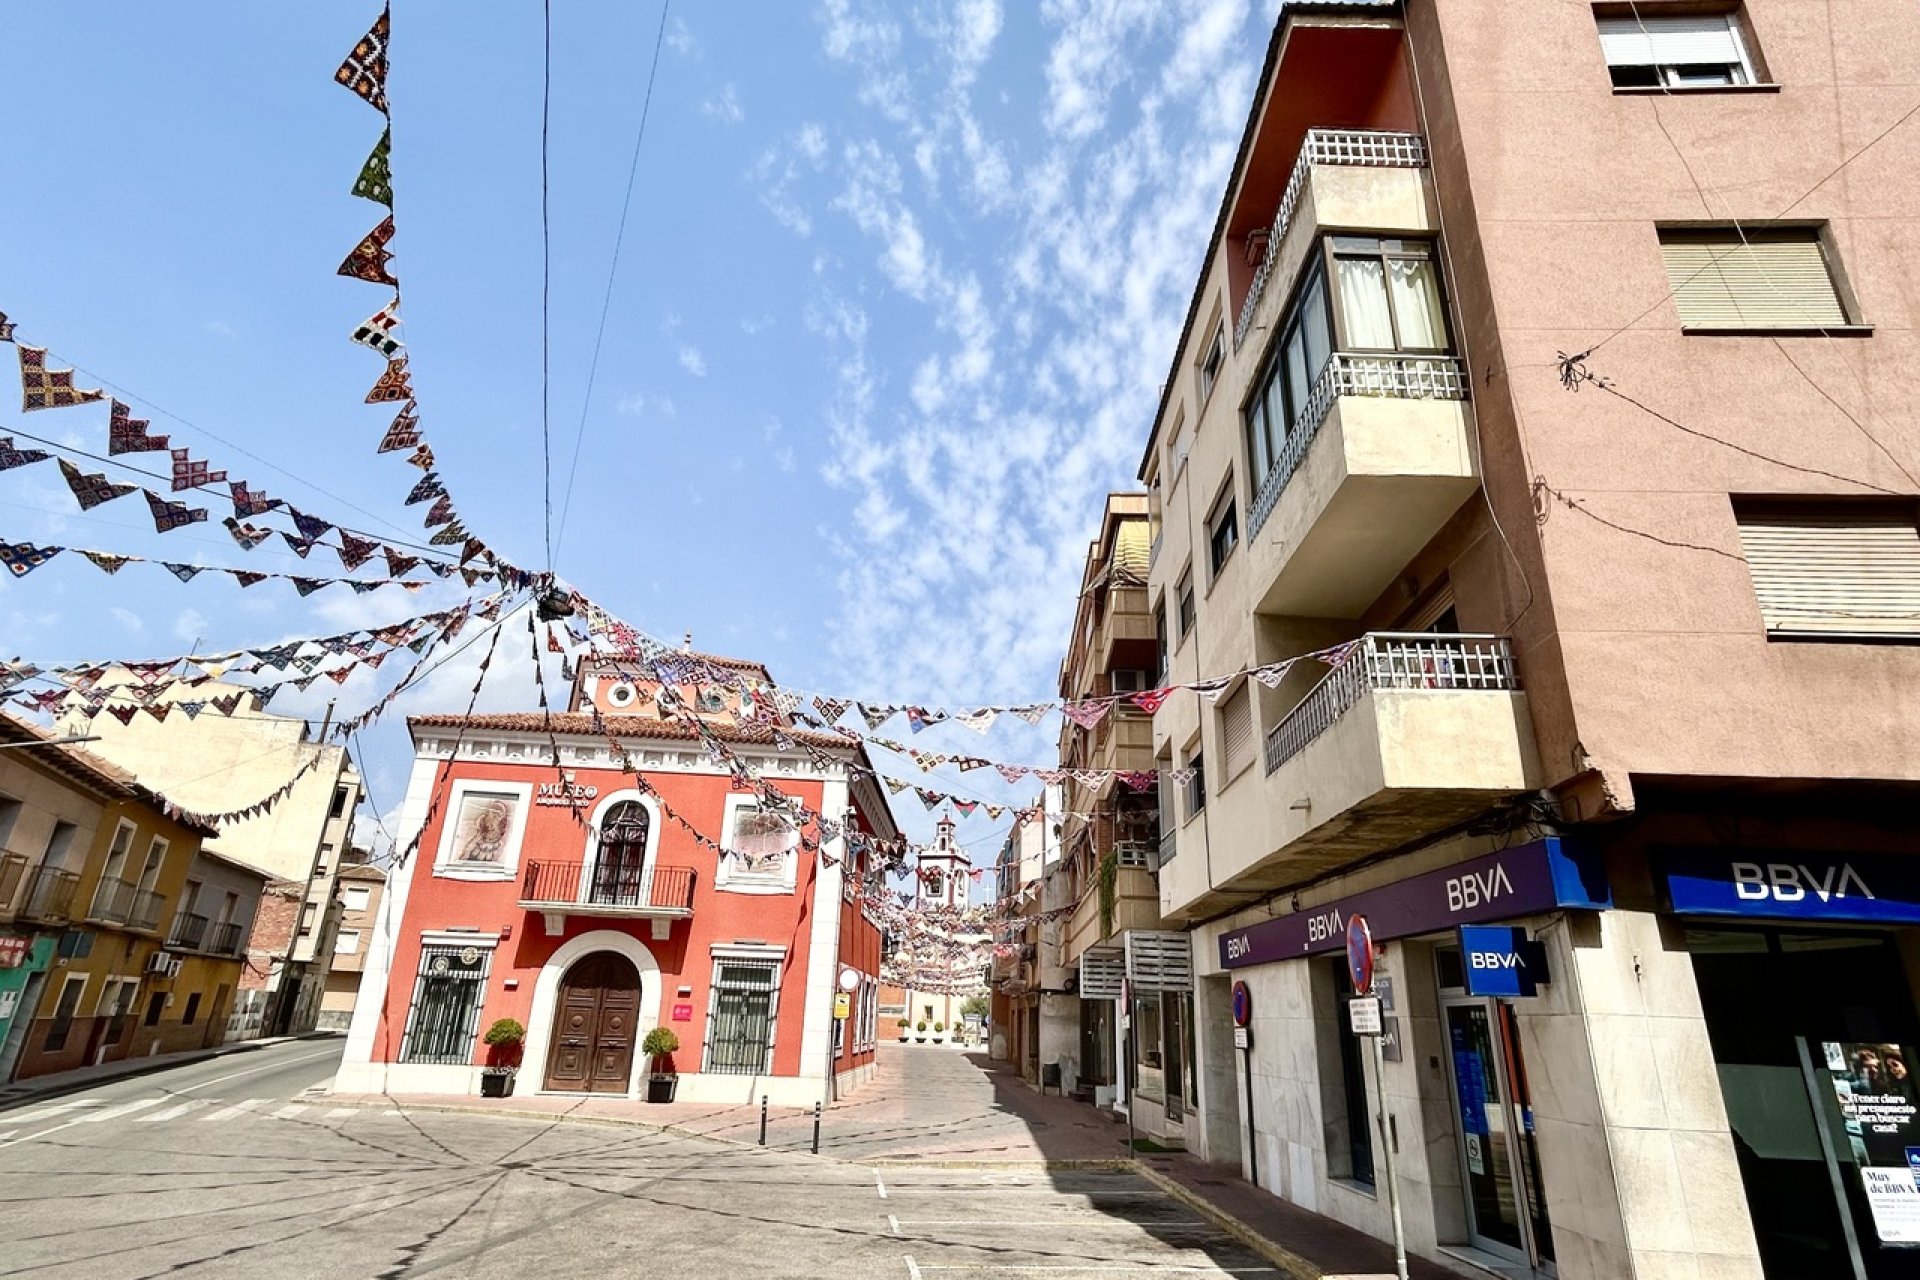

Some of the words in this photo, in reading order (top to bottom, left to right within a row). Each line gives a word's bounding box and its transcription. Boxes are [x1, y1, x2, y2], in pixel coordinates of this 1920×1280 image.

[538, 783, 598, 799] MUSEO
[1446, 863, 1513, 912] BBVA
[1731, 862, 1875, 902] BBVA
[1308, 908, 1344, 942] BBVA
[1228, 934, 1250, 959] BBVA
[1471, 952, 1526, 969] BBVA
[1880, 1093, 1906, 1104] claro
[1858, 1104, 1917, 1115] presupuesto
[1877, 1113, 1911, 1124] buscar
[1872, 1123, 1898, 1133] casa?
[1866, 1171, 1890, 1182] Muy
[1870, 1183, 1883, 1194] de
[1884, 1183, 1915, 1194] BBVA
